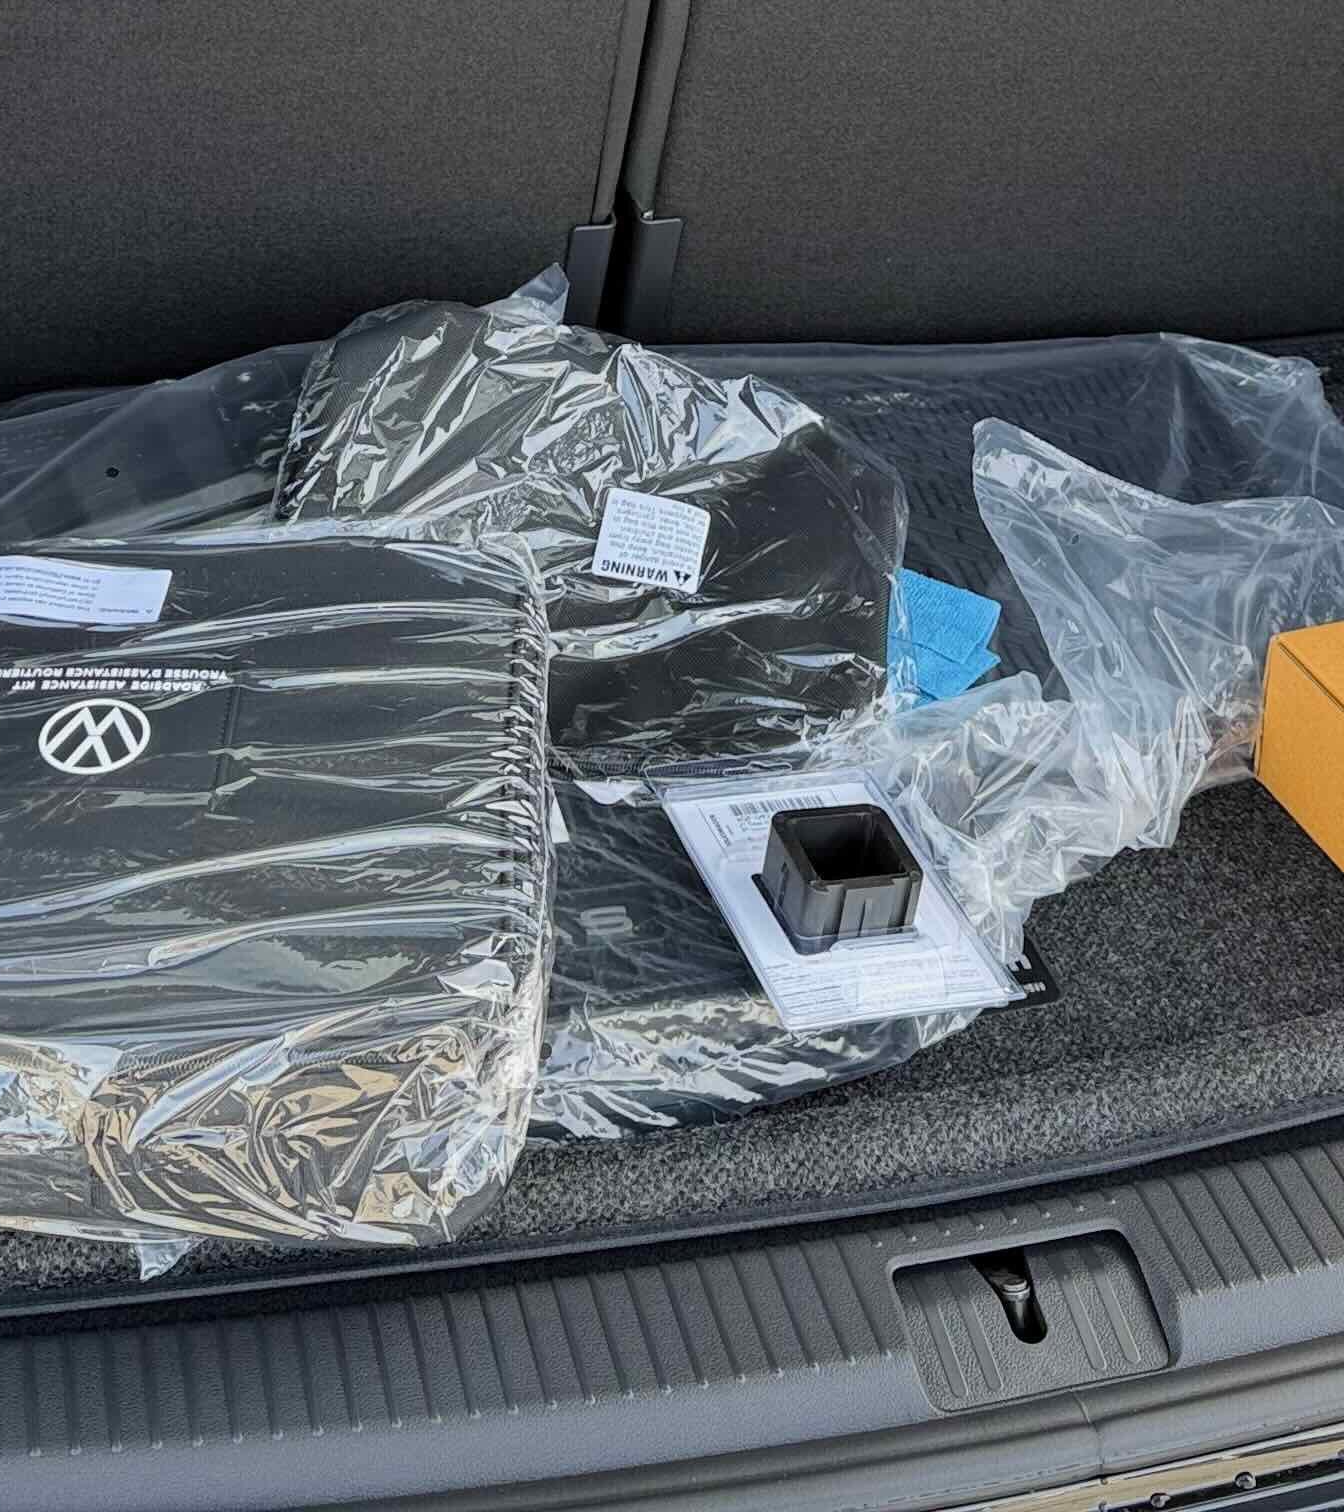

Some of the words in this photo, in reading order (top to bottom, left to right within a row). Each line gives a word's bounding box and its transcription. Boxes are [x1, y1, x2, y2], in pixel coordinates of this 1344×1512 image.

[600, 559, 668, 583] WARNING
[66, 667, 162, 679] D'ASSISTANCE
[164, 668, 227, 681] TROUSSE
[11, 680, 36, 691] KIT
[41, 680, 124, 691] ASSISTANCE
[131, 680, 204, 692] ROADSIDE
